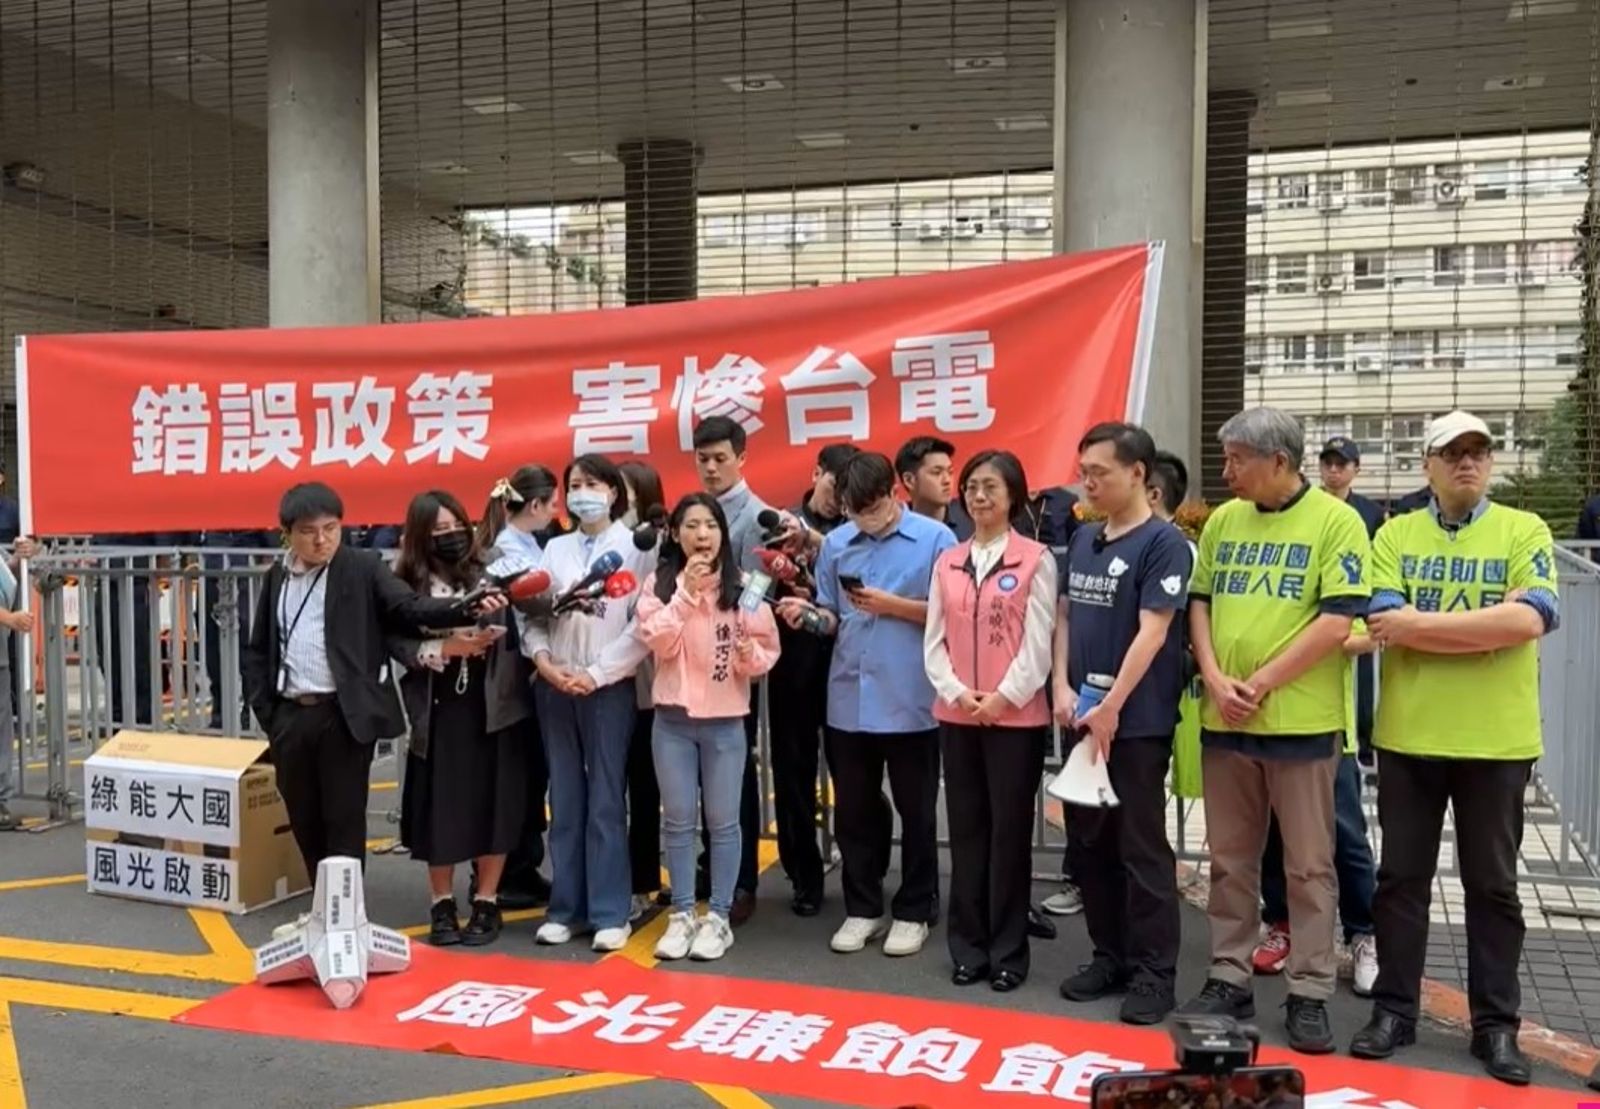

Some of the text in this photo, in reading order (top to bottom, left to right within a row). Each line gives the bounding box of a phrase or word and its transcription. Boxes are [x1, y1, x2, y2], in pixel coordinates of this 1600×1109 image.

[132, 330, 996, 475] 錯誤政策 害慘台電
[91, 774, 231, 828] 綠能大國
[94, 847, 231, 901] 風光啟動
[397, 980, 1145, 1103] 風光賺飽飽
